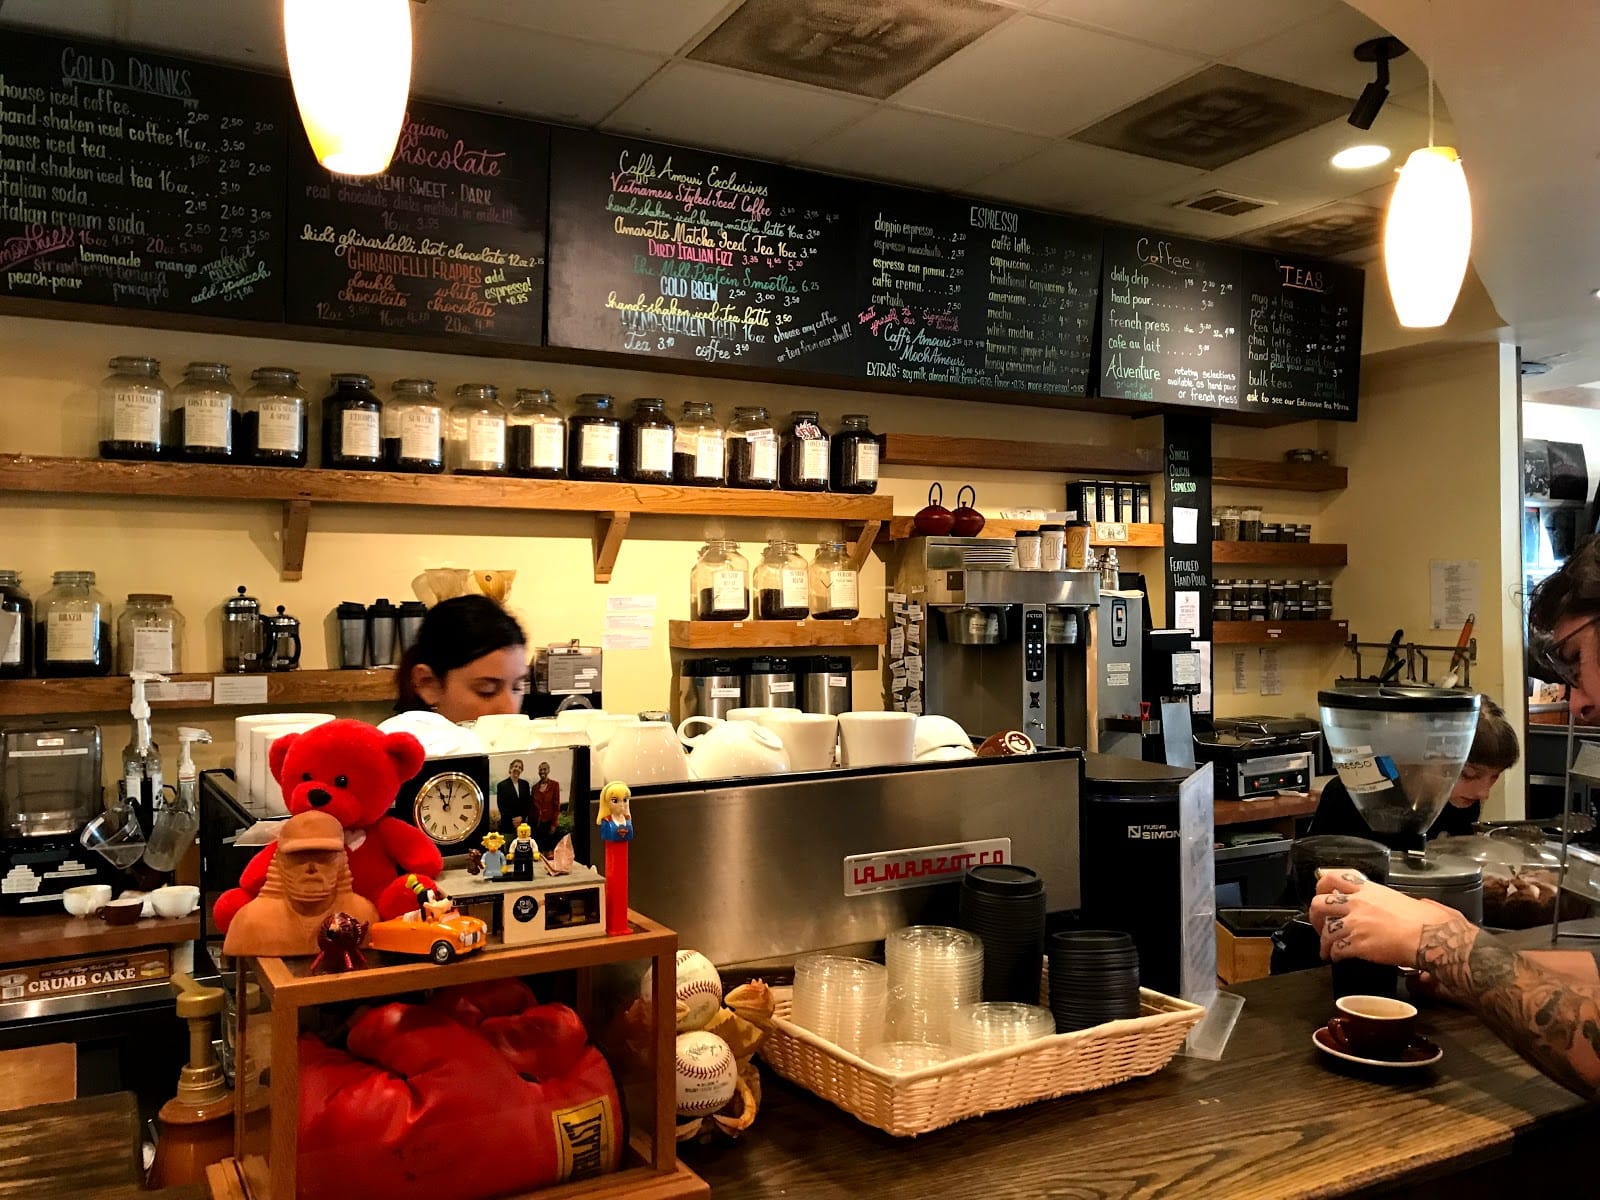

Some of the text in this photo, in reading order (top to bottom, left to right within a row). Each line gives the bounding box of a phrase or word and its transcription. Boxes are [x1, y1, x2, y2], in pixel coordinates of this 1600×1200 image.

[61, 46, 192, 97] COLD DRINKS
[0, 74, 130, 115] house iced coffee
[0, 124, 106, 159] house iced tea
[98, 117, 123, 139] iced
[128, 121, 174, 146] coffee
[97, 166, 153, 190] iced tea
[657, 156, 702, 186] Amouri
[707, 165, 768, 196] Exclusives
[51, 183, 88, 206] soda
[460, 183, 492, 206] DARK
[610, 171, 772, 222] Vietnamese Styled Iced Coffee
[51, 209, 146, 236] cream soda
[673, 209, 786, 237] iced honey matcha latte
[874, 212, 934, 242] doppio espresso
[970, 206, 1019, 233] ESPRESSO
[614, 215, 775, 256] Amaretto Matcha Iced Tea
[80, 244, 141, 267] lemonade
[418, 238, 448, 256] hot
[447, 243, 508, 265] chocolate
[648, 238, 734, 267] DIRTY ITALIAN FIZZ
[1136, 237, 1193, 270] Coffee
[154, 260, 197, 279] mango
[347, 246, 482, 283] GHIRARDELLI FRAPPES
[484, 268, 505, 284] add
[873, 257, 905, 273] espresso
[347, 270, 397, 291] double
[660, 275, 687, 298] COLD
[691, 280, 718, 301] BREW
[691, 262, 739, 287] Protein
[743, 267, 798, 294] Smoothie
[1110, 265, 1130, 288] daily
[1131, 268, 1150, 289] drip
[1280, 265, 1324, 289] TEAS
[337, 287, 412, 308] chocolate
[434, 282, 482, 301] white
[484, 276, 533, 304] espresso!
[1111, 287, 1131, 305] hand
[1132, 295, 1152, 309] pour
[427, 296, 498, 318] chocolate
[691, 301, 720, 321] iced
[719, 304, 741, 323] tea
[741, 306, 771, 327] latte
[773, 310, 839, 344] choose any coffee
[1109, 308, 1142, 330] french
[1144, 320, 1170, 335] press
[624, 331, 651, 352] Tea
[912, 327, 952, 348] Amouri
[1129, 340, 1140, 349] au
[1143, 336, 1160, 353] lait
[1248, 332, 1266, 346] chai
[695, 339, 730, 362] coffee
[1248, 344, 1269, 360] hand
[1105, 352, 1161, 381] Adventure
[1202, 368, 1236, 381] selections
[1248, 369, 1268, 387] bulk
[1178, 387, 1238, 406] or french press
[1207, 378, 1223, 391] hand
[1261, 392, 1270, 403] to
[1271, 396, 1283, 405] see
[1284, 397, 1296, 406] our
[1170, 478, 1197, 493] ESPRESSO
[1169, 556, 1199, 572] FEATURED
[28, 974, 88, 993] CRUMB
[91, 967, 136, 985] CAKE
